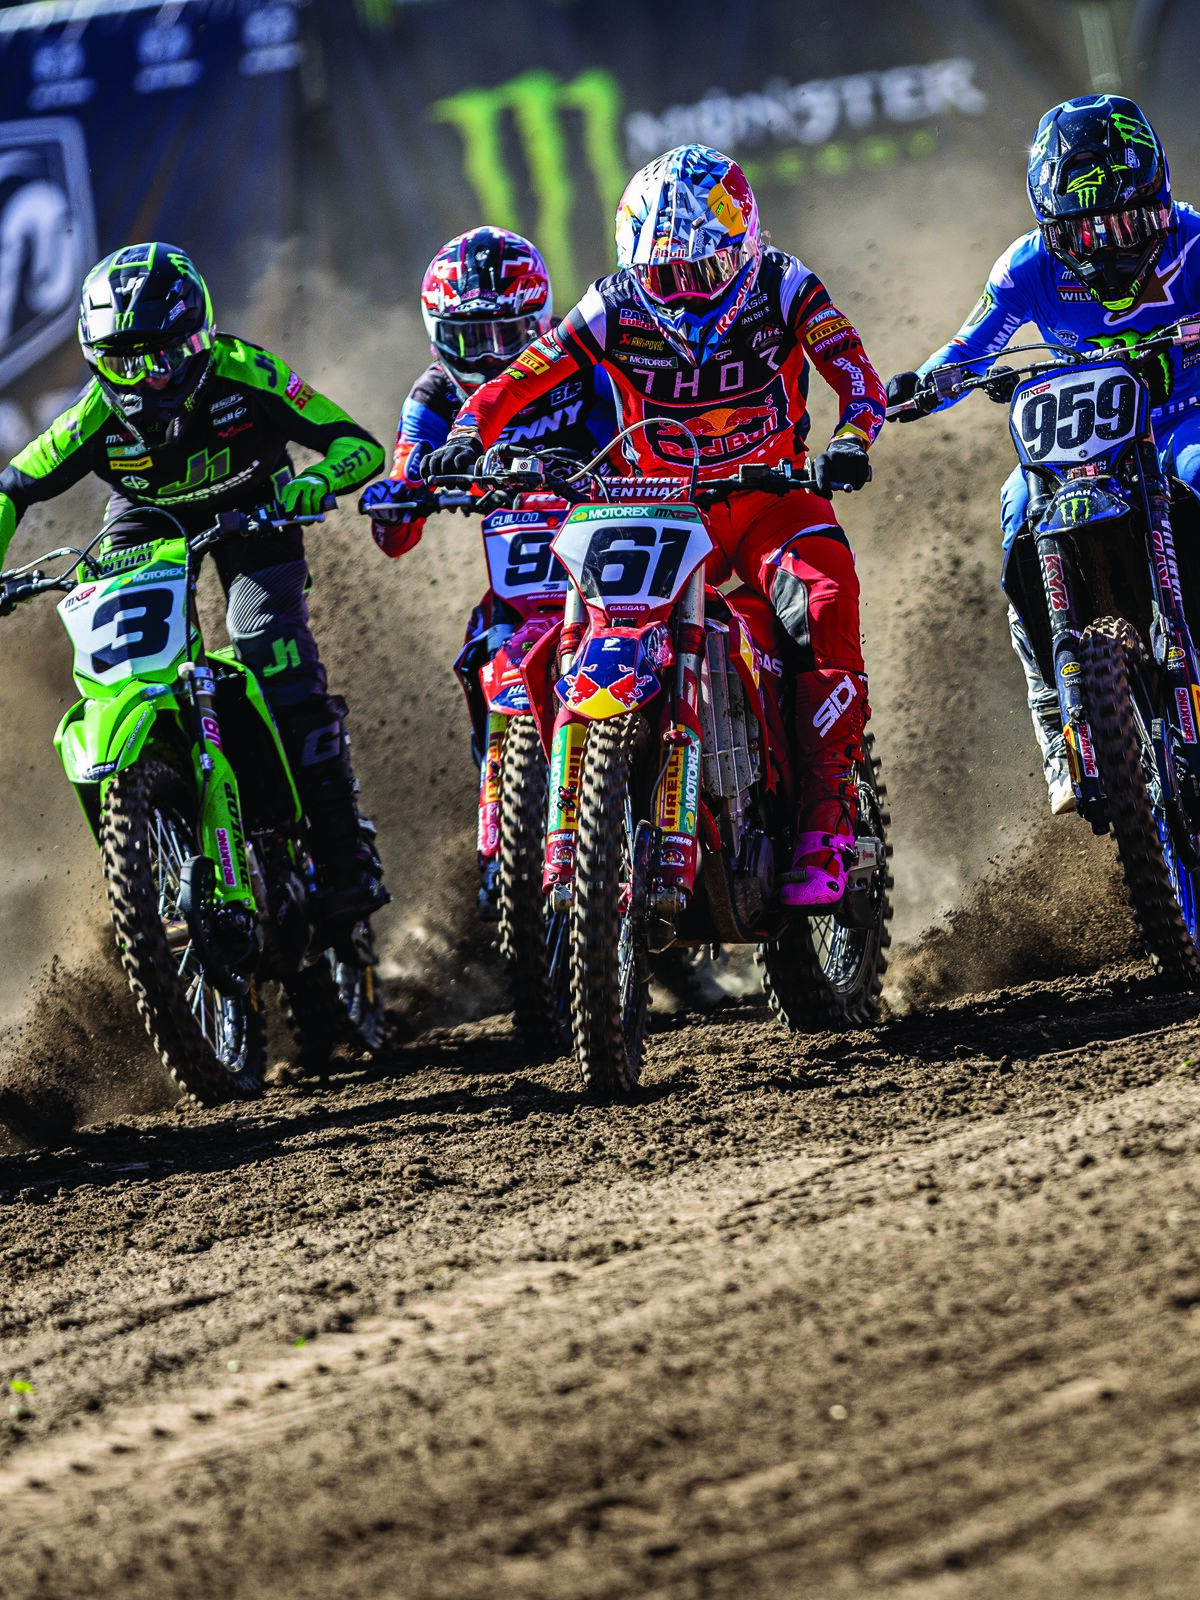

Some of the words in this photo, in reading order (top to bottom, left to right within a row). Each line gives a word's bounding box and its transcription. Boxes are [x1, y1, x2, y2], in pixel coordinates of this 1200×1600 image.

[629, 355, 672, 367] MOTOREX
[814, 329, 850, 354] BRISK
[1020, 383, 1052, 401] MXGP
[499, 400, 583, 444] ENNY
[657, 439, 724, 460] Red
[726, 411, 778, 448] Bull
[1021, 374, 1136, 461] 959
[490, 512, 540, 528] GUILLOD
[588, 506, 650, 519] MOTOREX
[132, 566, 184, 583] MOTOREX
[580, 525, 692, 600] 61
[1044, 554, 1069, 611] KYB
[64, 585, 97, 609] MXGP
[90, 587, 174, 674] 3
[1175, 688, 1196, 742] BRAKING
[217, 829, 235, 886] BRAKING
